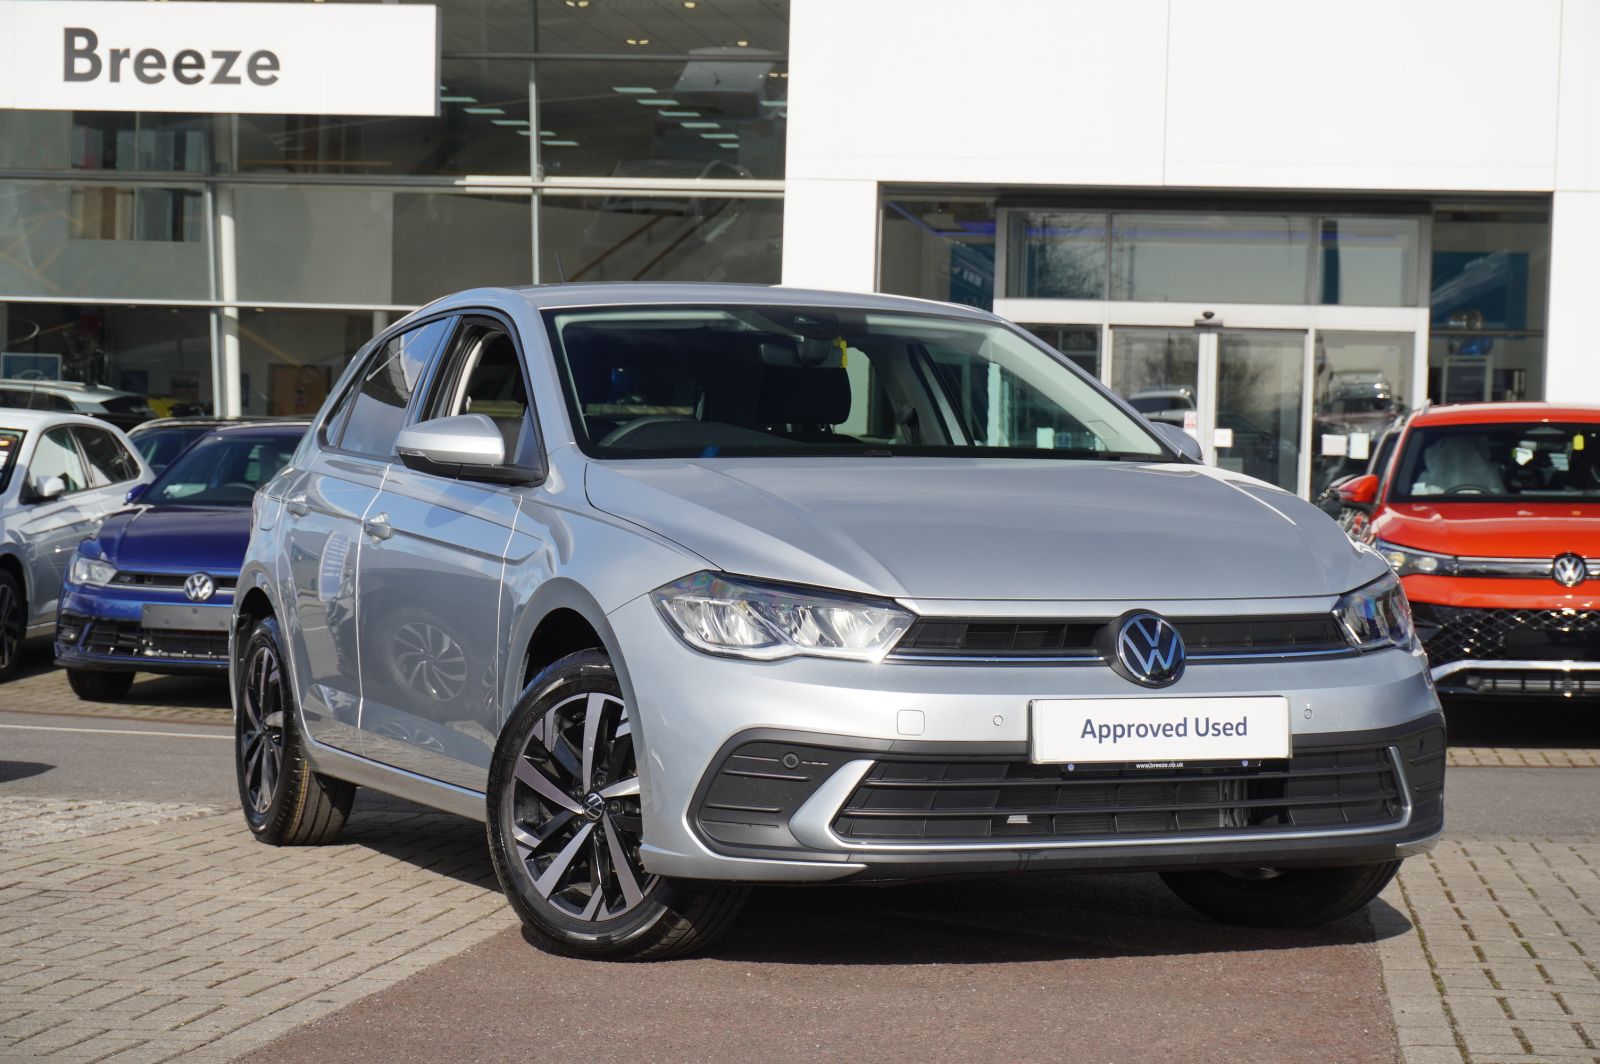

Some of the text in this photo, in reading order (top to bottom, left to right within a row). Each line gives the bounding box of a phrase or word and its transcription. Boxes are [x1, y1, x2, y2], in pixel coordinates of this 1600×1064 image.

[63, 27, 281, 86] Breeze
[184, 574, 213, 600] VW
[1120, 615, 1182, 680] VW
[1080, 716, 1248, 744] Approved Used
[1135, 761, 1184, 769] www.breeze.co.uk
